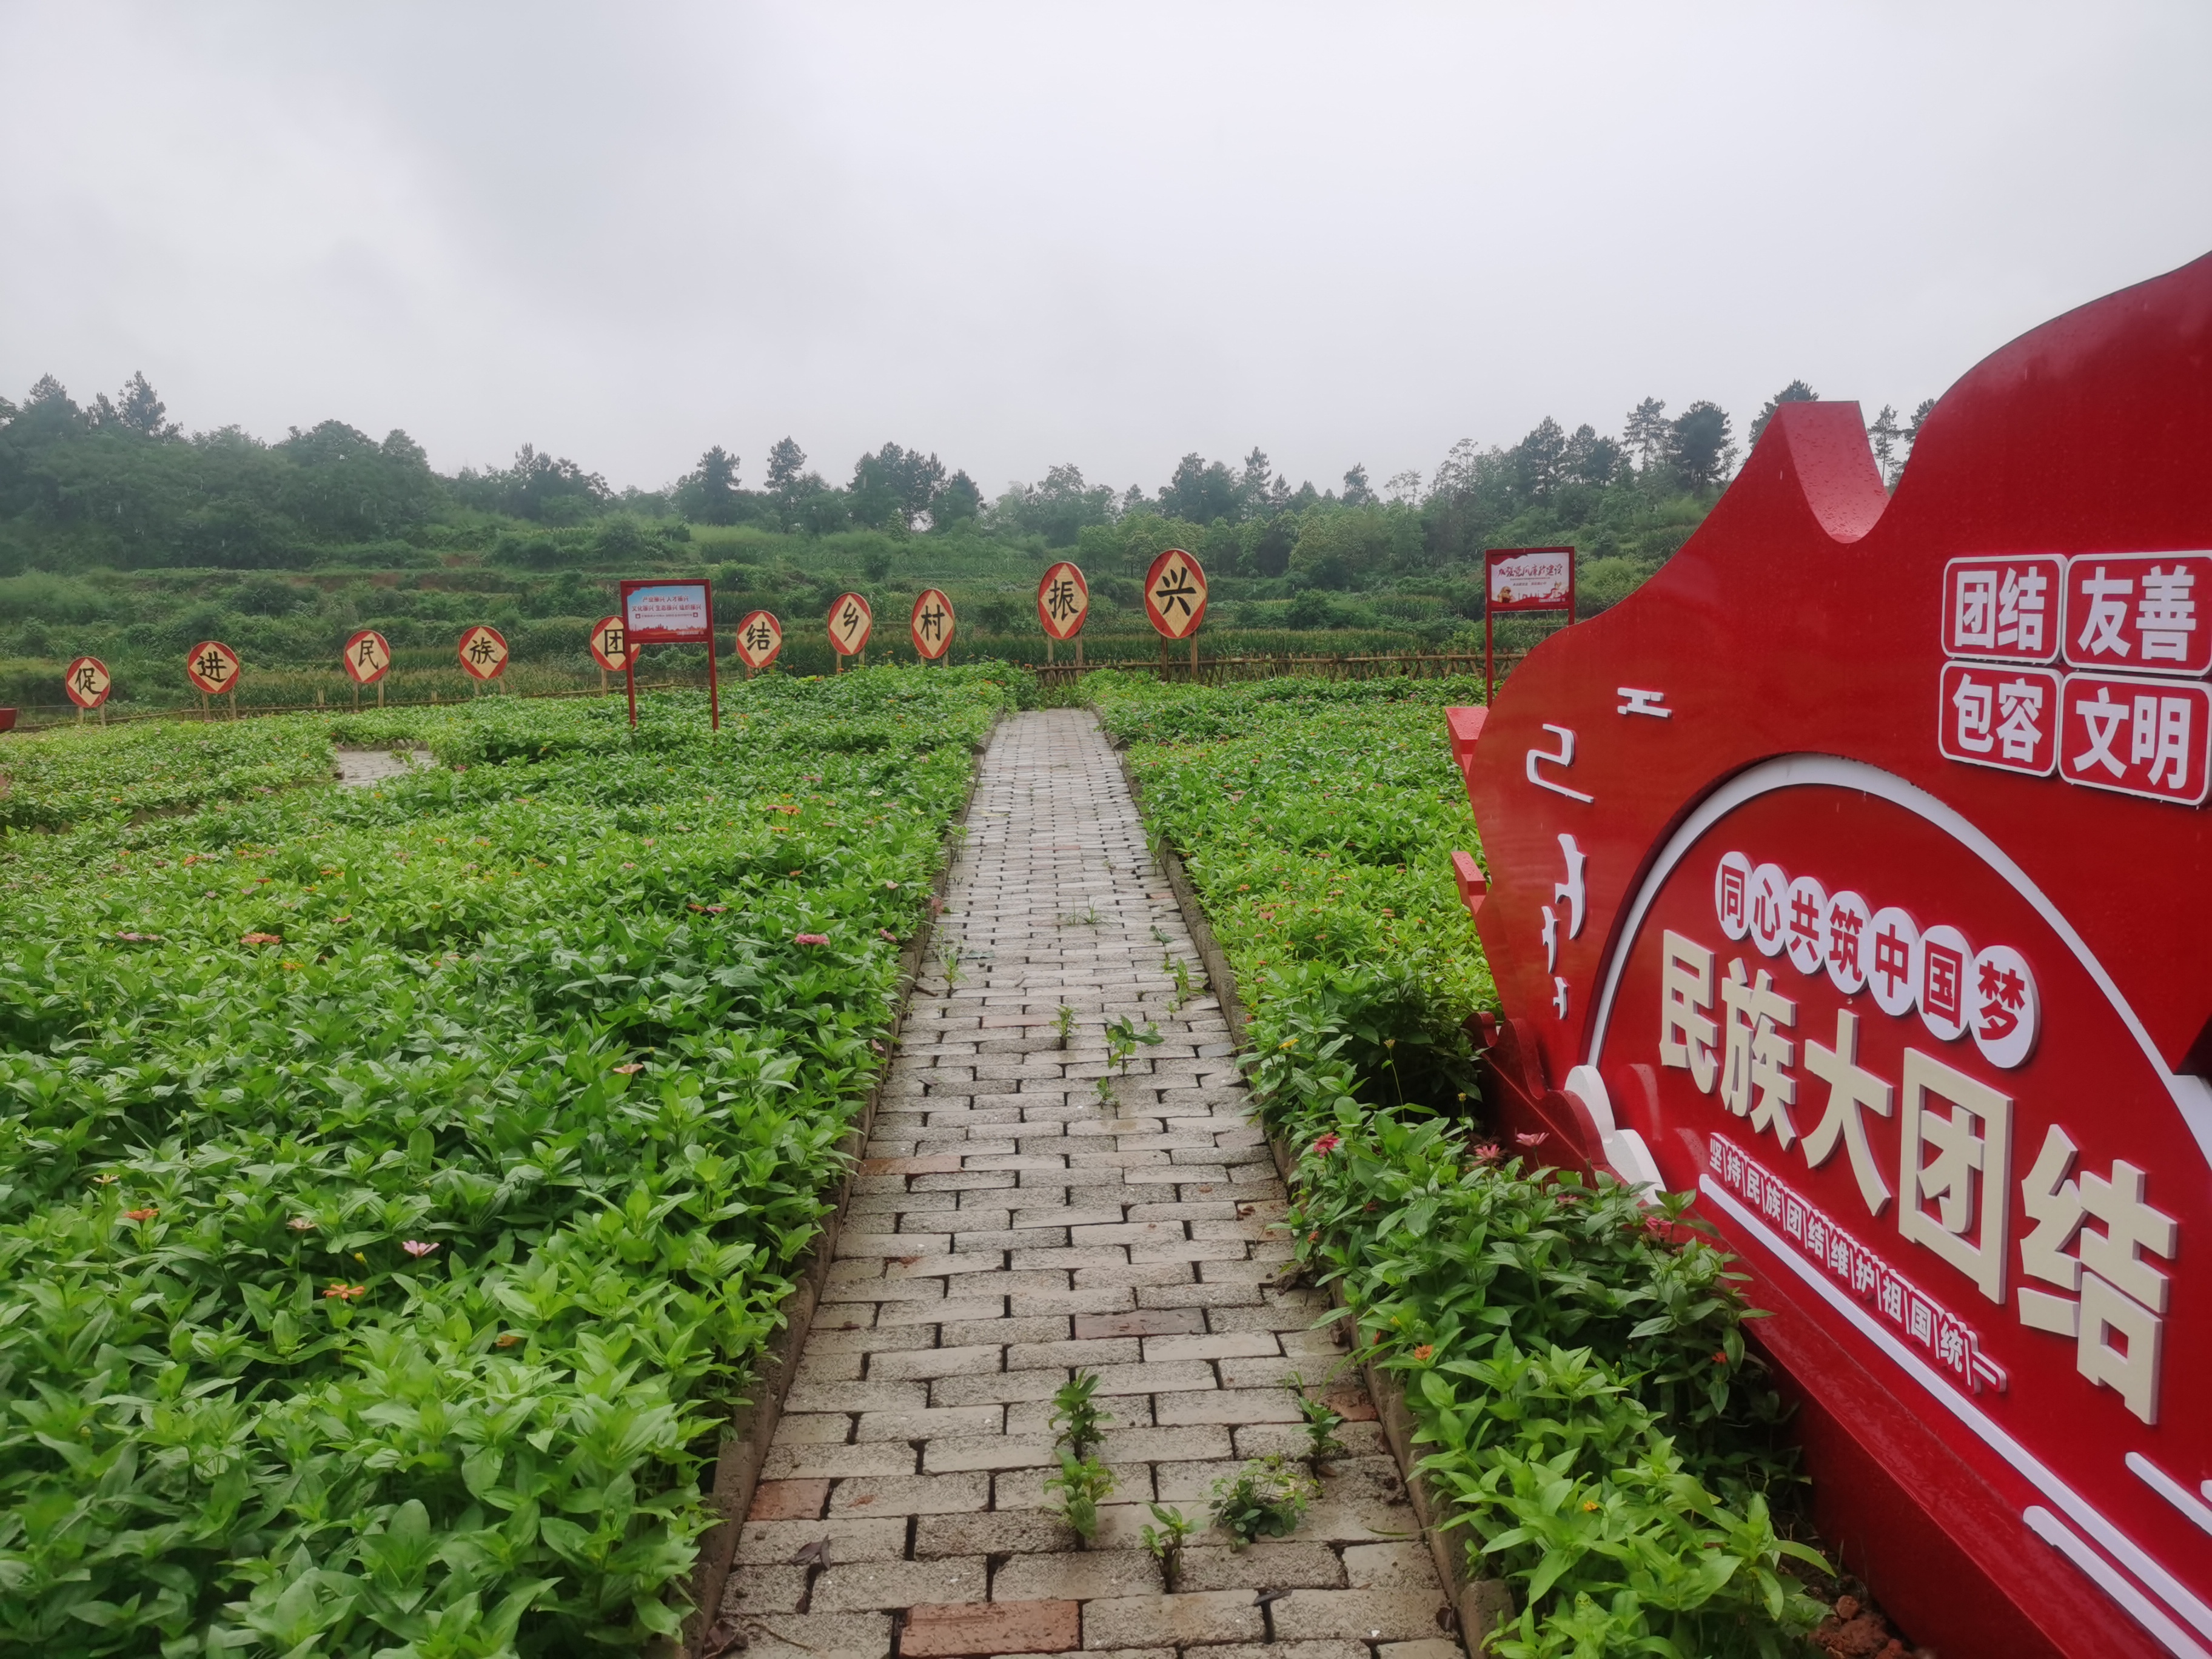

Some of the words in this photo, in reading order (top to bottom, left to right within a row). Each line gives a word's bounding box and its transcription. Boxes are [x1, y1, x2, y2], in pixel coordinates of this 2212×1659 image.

[1048, 578, 1079, 622] 振
[1156, 566, 1197, 617] 兴
[1954, 566, 2047, 651] 团结
[842, 602, 860, 642] 乡
[920, 604, 945, 642] 村
[2077, 565, 2197, 662] 友善
[357, 639, 380, 669] 民
[468, 637, 500, 666] 族
[605, 628, 625, 657] 团
[746, 622, 771, 652] 结
[74, 667, 102, 695] 促
[196, 652, 227, 683] 进
[1952, 673, 2043, 763] 包容
[2073, 686, 2192, 789] 文明
[1719, 862, 2026, 1042] 同心共筑中国梦
[1658, 929, 2178, 1426] 民族大团结
